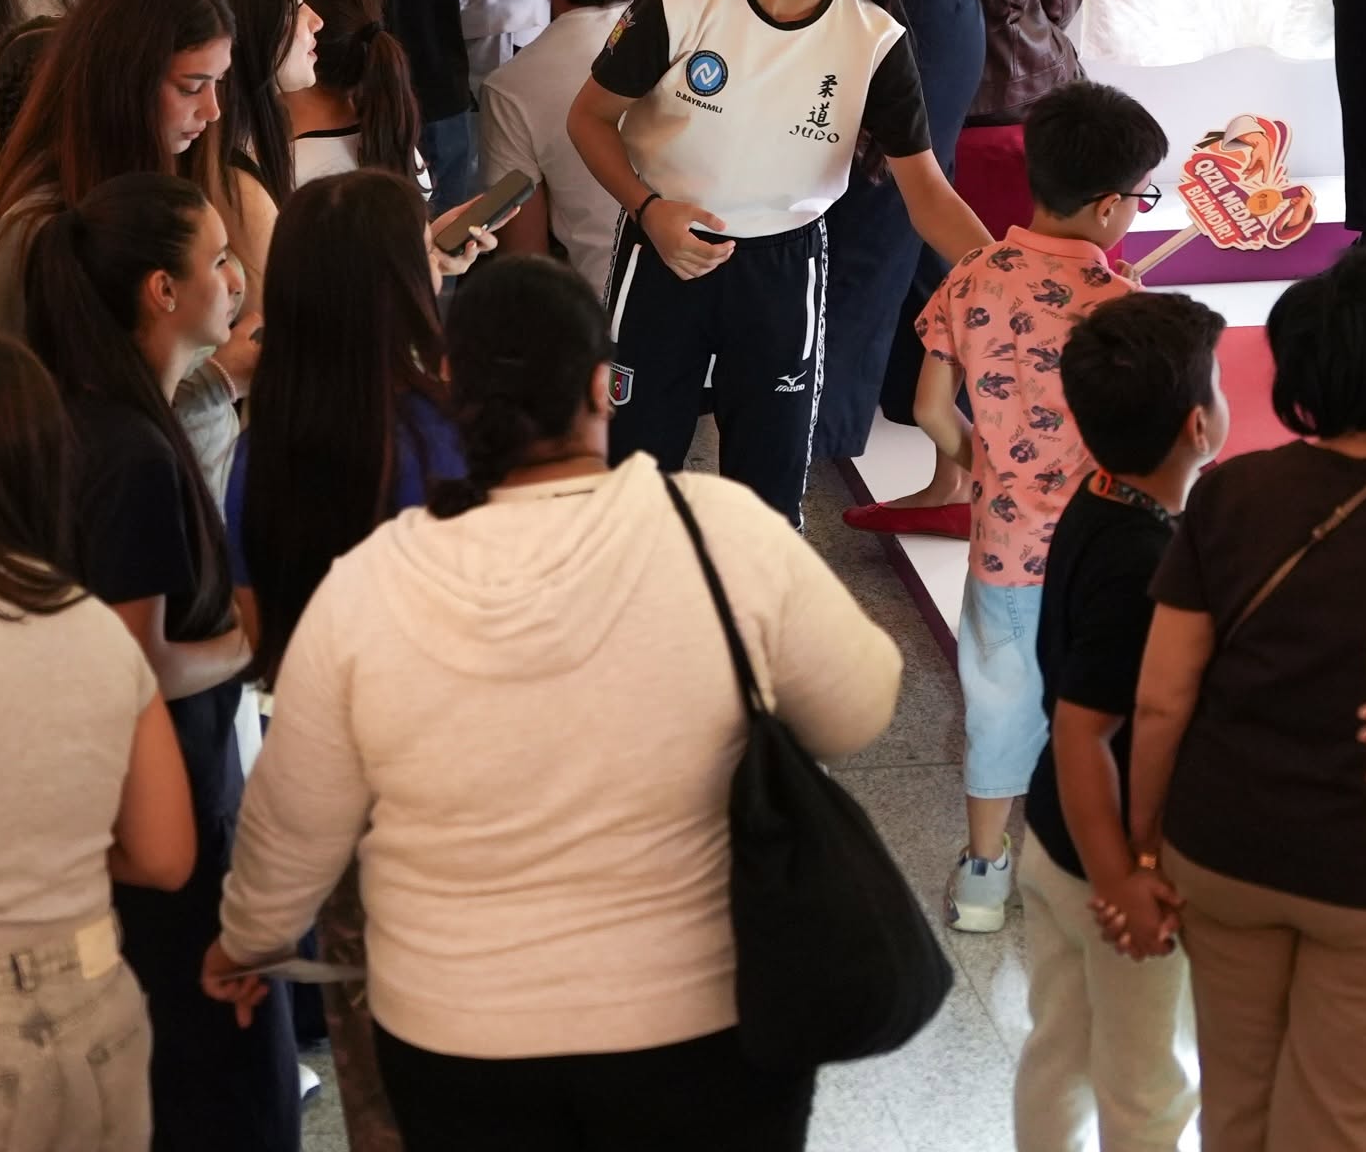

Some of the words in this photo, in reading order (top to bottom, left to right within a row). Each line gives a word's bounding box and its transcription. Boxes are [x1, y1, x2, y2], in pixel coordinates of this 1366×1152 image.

[675, 90, 723, 114] D.BAYRAMLI
[805, 74, 839, 128] 柔道
[789, 124, 841, 144] JUDO
[1194, 158, 1231, 194] QIZIL
[1218, 190, 1262, 239] MEDAL
